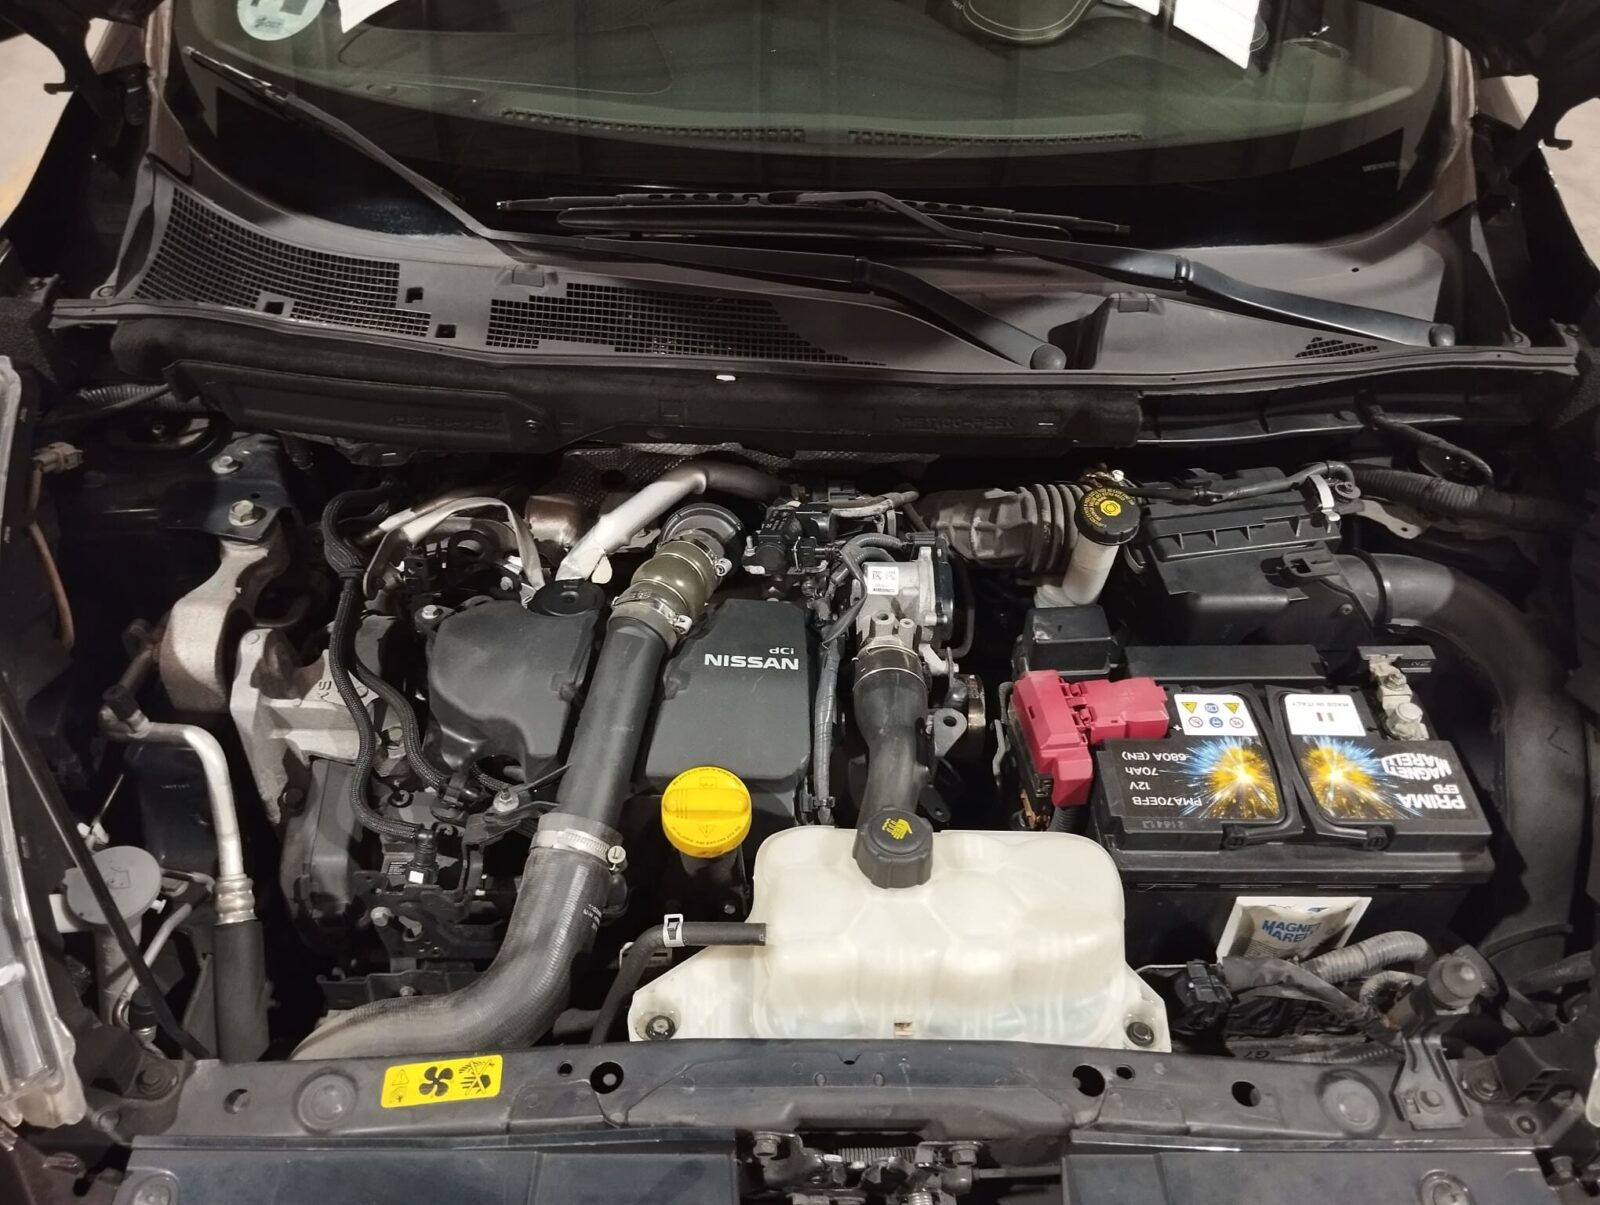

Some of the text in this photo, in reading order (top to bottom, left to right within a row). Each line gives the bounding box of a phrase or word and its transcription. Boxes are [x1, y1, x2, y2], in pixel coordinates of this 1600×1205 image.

[704, 653, 799, 670] NISSAN
[1121, 751, 1187, 761] 680A (EN)
[1125, 766, 1159, 776] 70Ah
[1129, 781, 1151, 790] 12V
[1432, 784, 1460, 794] EFB
[1131, 796, 1203, 807] PMA70EFB
[1394, 793, 1467, 809] PRIMA
